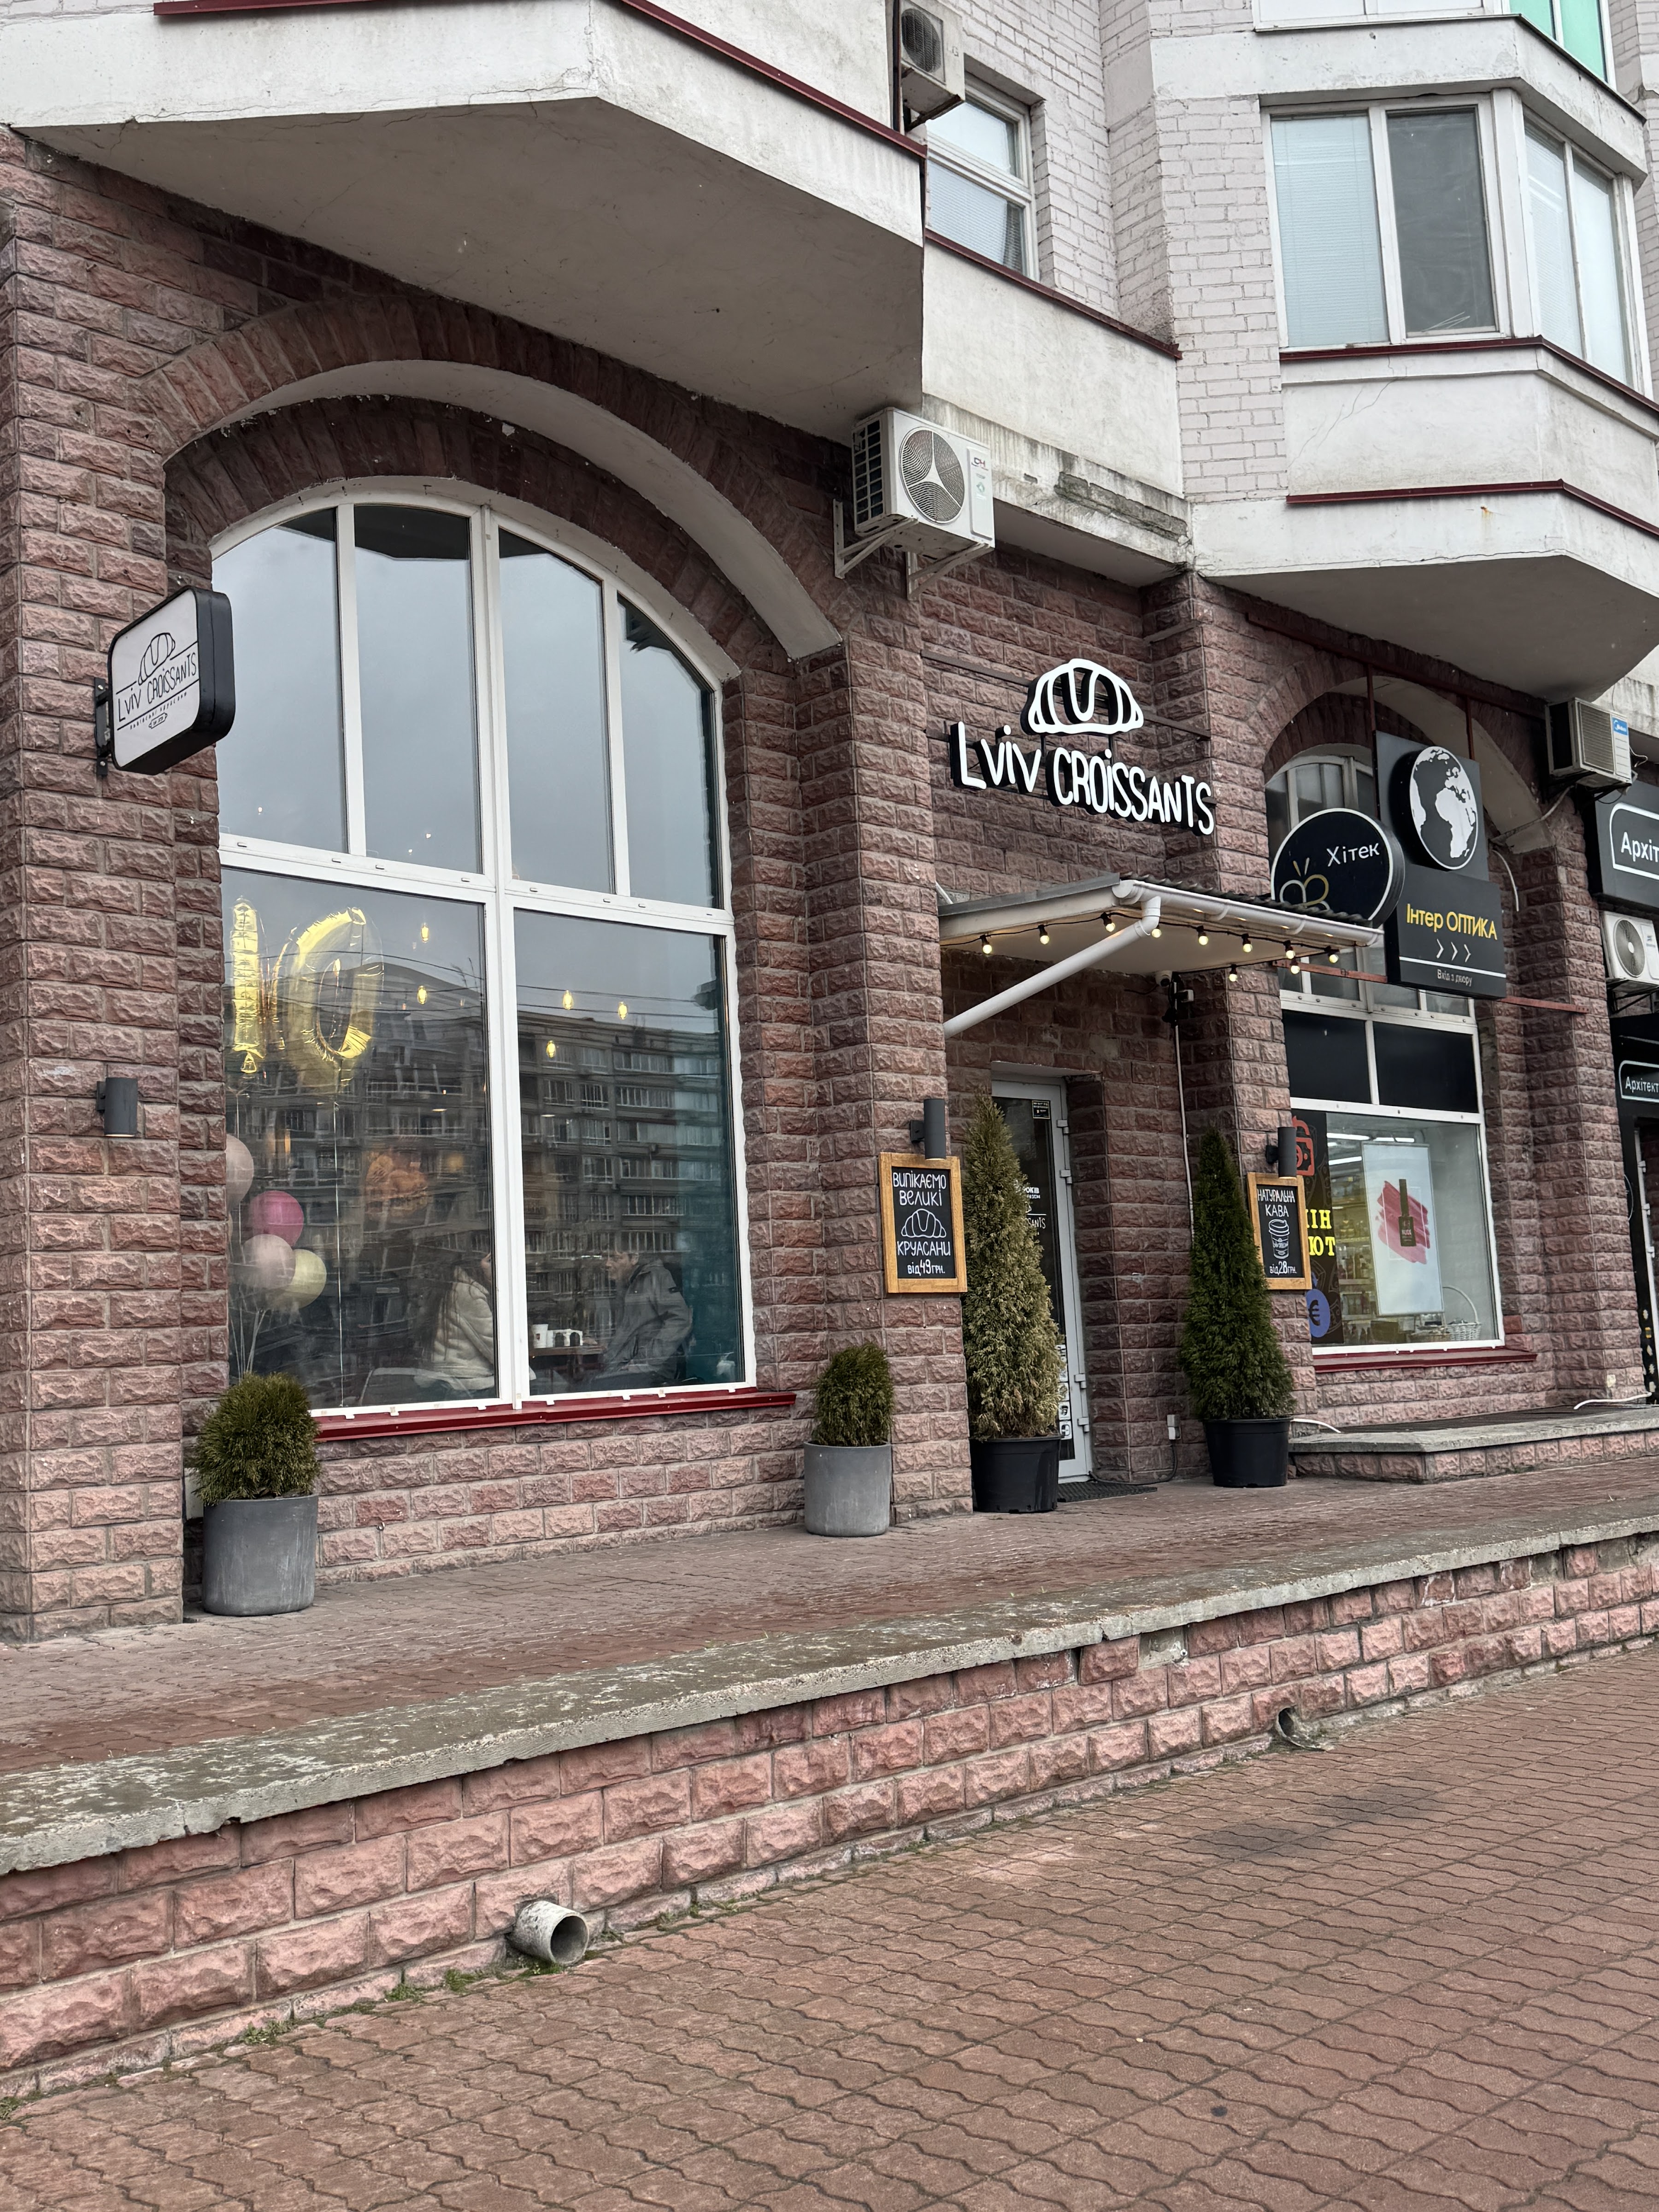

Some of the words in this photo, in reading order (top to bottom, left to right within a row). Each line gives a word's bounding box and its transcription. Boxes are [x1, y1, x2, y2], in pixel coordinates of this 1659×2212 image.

[1326, 843, 1380, 867] Хітек
[1406, 903, 1443, 932] Інтер
[1446, 912, 1498, 940] ОПТИКА
[1625, 1076, 1659, 1093] Архітект
[1265, 1204, 1289, 1217] КАВА
[897, 1241, 951, 1256] КРУАСАНИ
